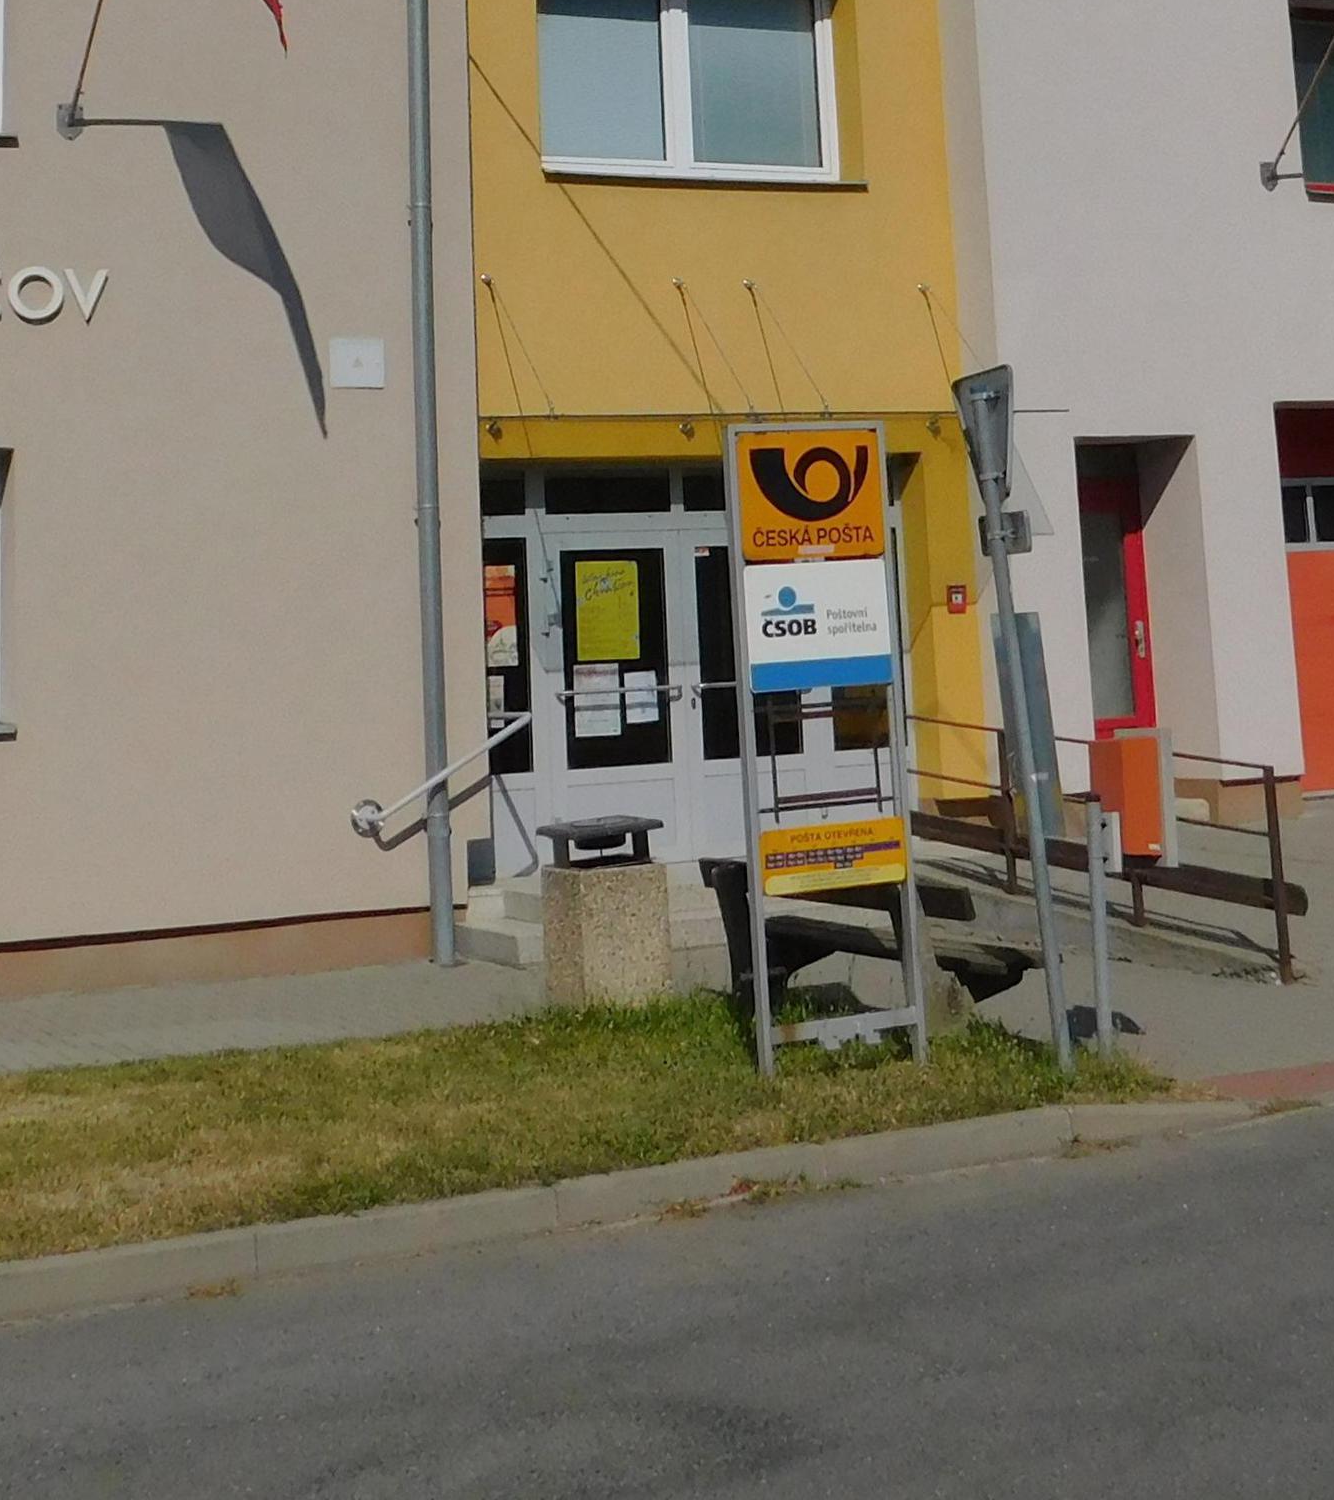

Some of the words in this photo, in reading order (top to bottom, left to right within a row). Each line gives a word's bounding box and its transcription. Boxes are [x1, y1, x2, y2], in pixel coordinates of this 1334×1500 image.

[752, 525, 812, 547] ČESKÁ
[817, 523, 874, 544] POŠTA
[826, 608, 868, 619] Poštovní
[761, 617, 818, 639] ČSOB
[827, 621, 878, 637] spořitelna
